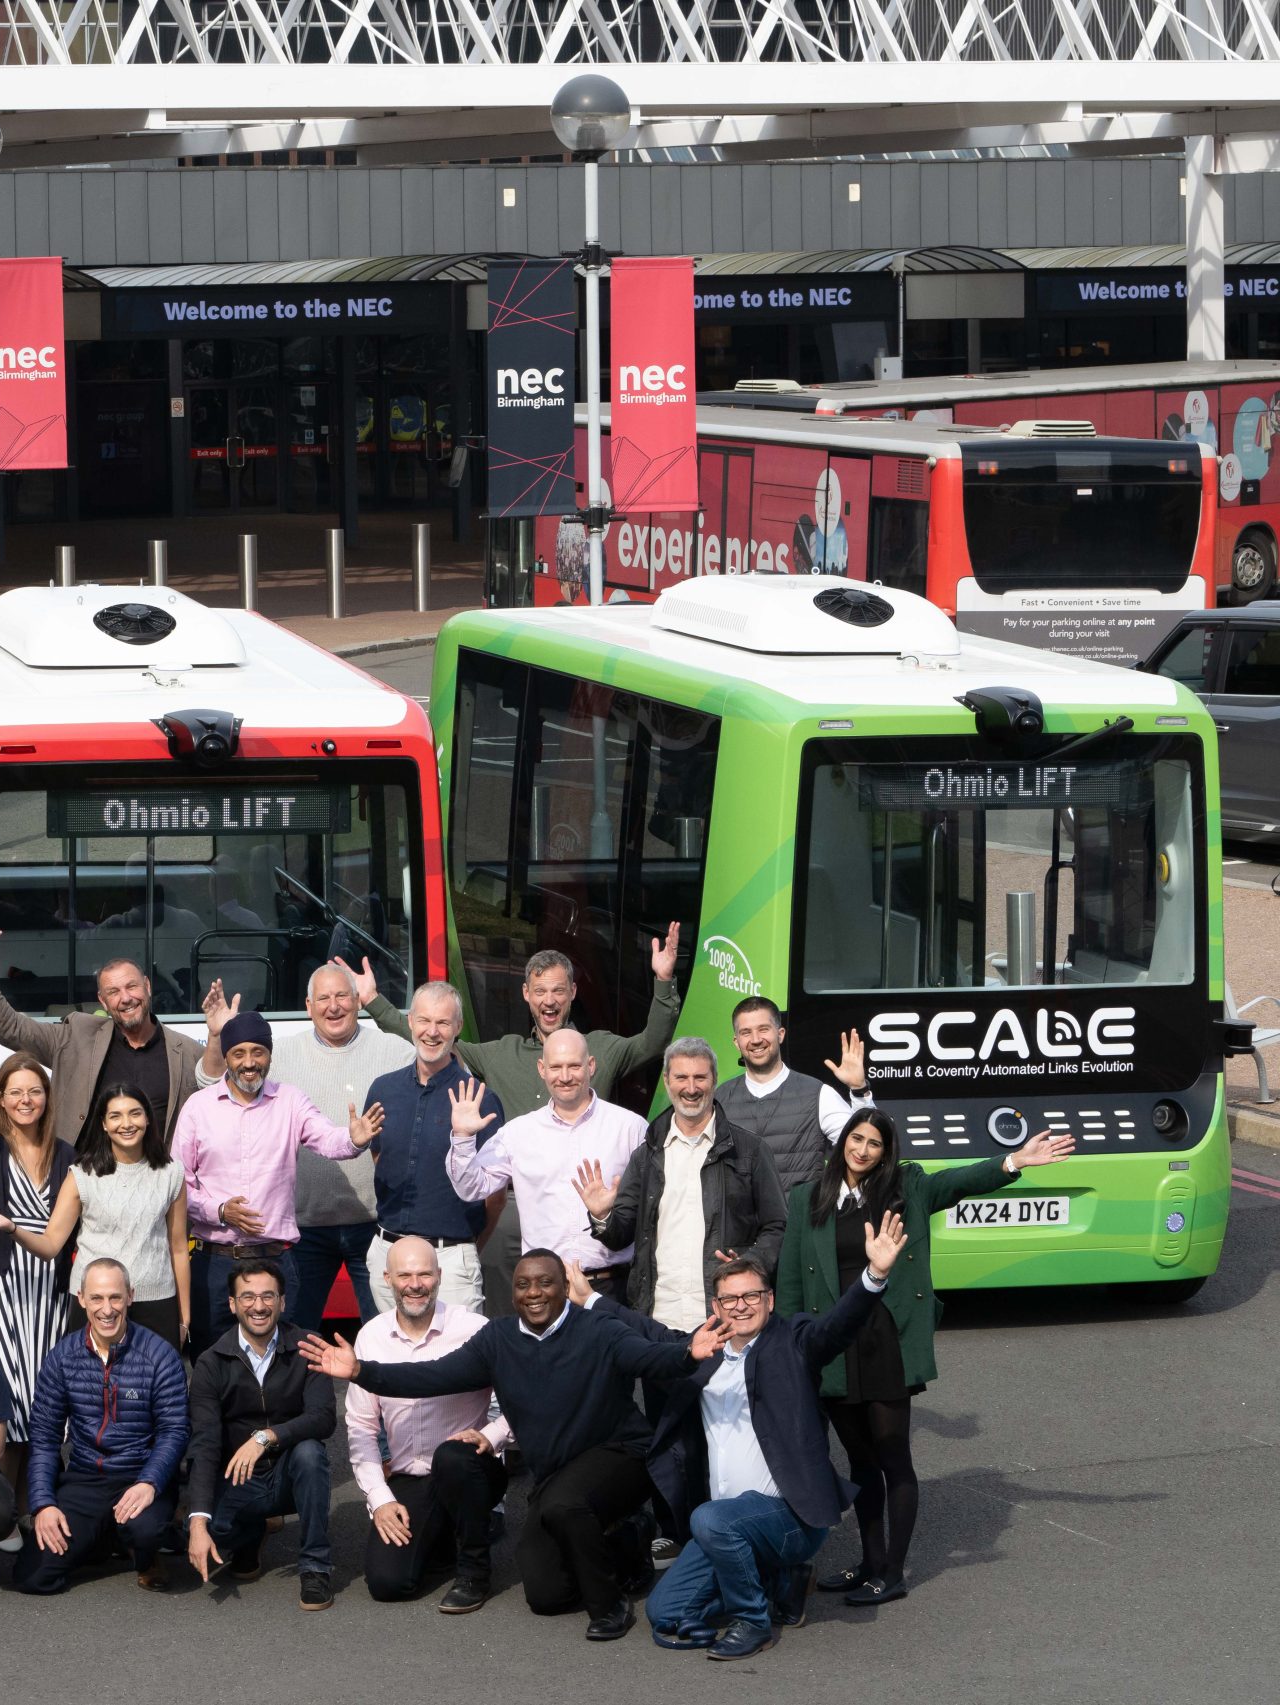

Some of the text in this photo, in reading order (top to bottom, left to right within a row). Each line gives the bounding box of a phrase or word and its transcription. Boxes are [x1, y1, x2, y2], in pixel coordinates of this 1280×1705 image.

[741, 290, 763, 308] to
[768, 288, 804, 307] the
[809, 288, 852, 306] NEC
[1078, 281, 1170, 300] Welcome
[1175, 280, 1187, 297] t
[1239, 278, 1279, 296] NEC
[163, 298, 393, 321] Welcome to the NEC
[497, 368, 564, 394] nec
[620, 364, 686, 390] nec
[497, 396, 564, 409] Birmingham
[620, 392, 686, 405] Birmingham
[618, 513, 789, 589] experiences
[1004, 618, 1156, 628] Pay for your parking online at any point
[1049, 630, 1110, 639] during your visit
[924, 767, 1077, 797] Ohmio LIFT
[103, 797, 296, 829] Ohmio LIFT
[709, 947, 736, 974] 100%
[719, 968, 762, 997] electric
[868, 1007, 1136, 1062] SCALE
[868, 1060, 1133, 1079] Solihull & Coventry Automated Links Evolution
[956, 1200, 1060, 1224] KX24 DYG
